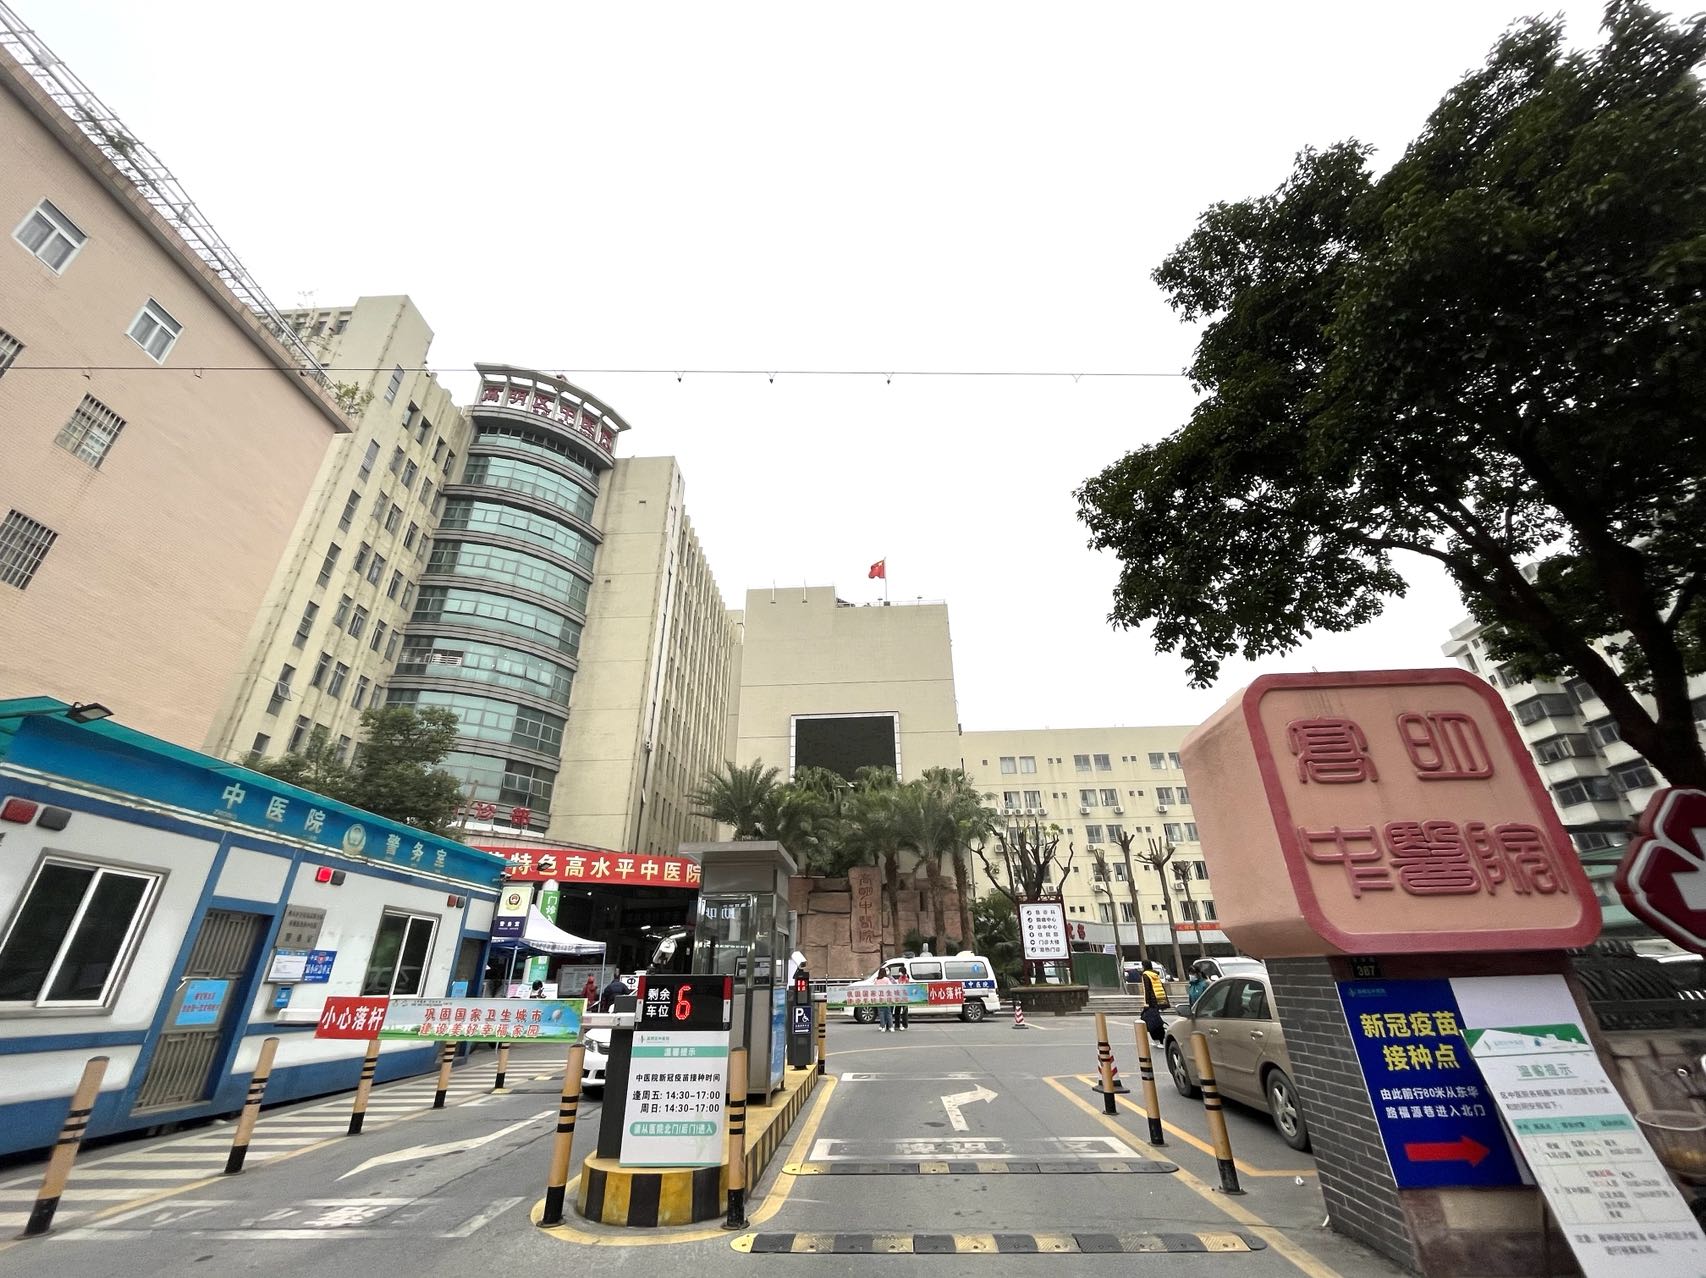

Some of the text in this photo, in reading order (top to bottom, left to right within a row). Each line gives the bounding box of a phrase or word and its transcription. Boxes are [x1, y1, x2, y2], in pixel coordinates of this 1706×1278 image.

[929, 985, 963, 1000] 小心落杆
[647, 984, 692, 1021] 剩余 6
[322, 1005, 385, 1032] 小心落杆
[424, 1007, 543, 1023] 巩固国家卫生城市
[646, 1005, 669, 1018] 车位
[418, 1023, 541, 1038] 建设美好幸福家园
[1360, 1010, 1460, 1038] 新冠疫苗
[1383, 1043, 1461, 1071] 接种点
[636, 1073, 721, 1082] 中医院新冠疫苗接种时间
[1380, 1085, 1480, 1101] 由此前行80米从东华
[1386, 1104, 1487, 1119] 路福源巷进入北门
